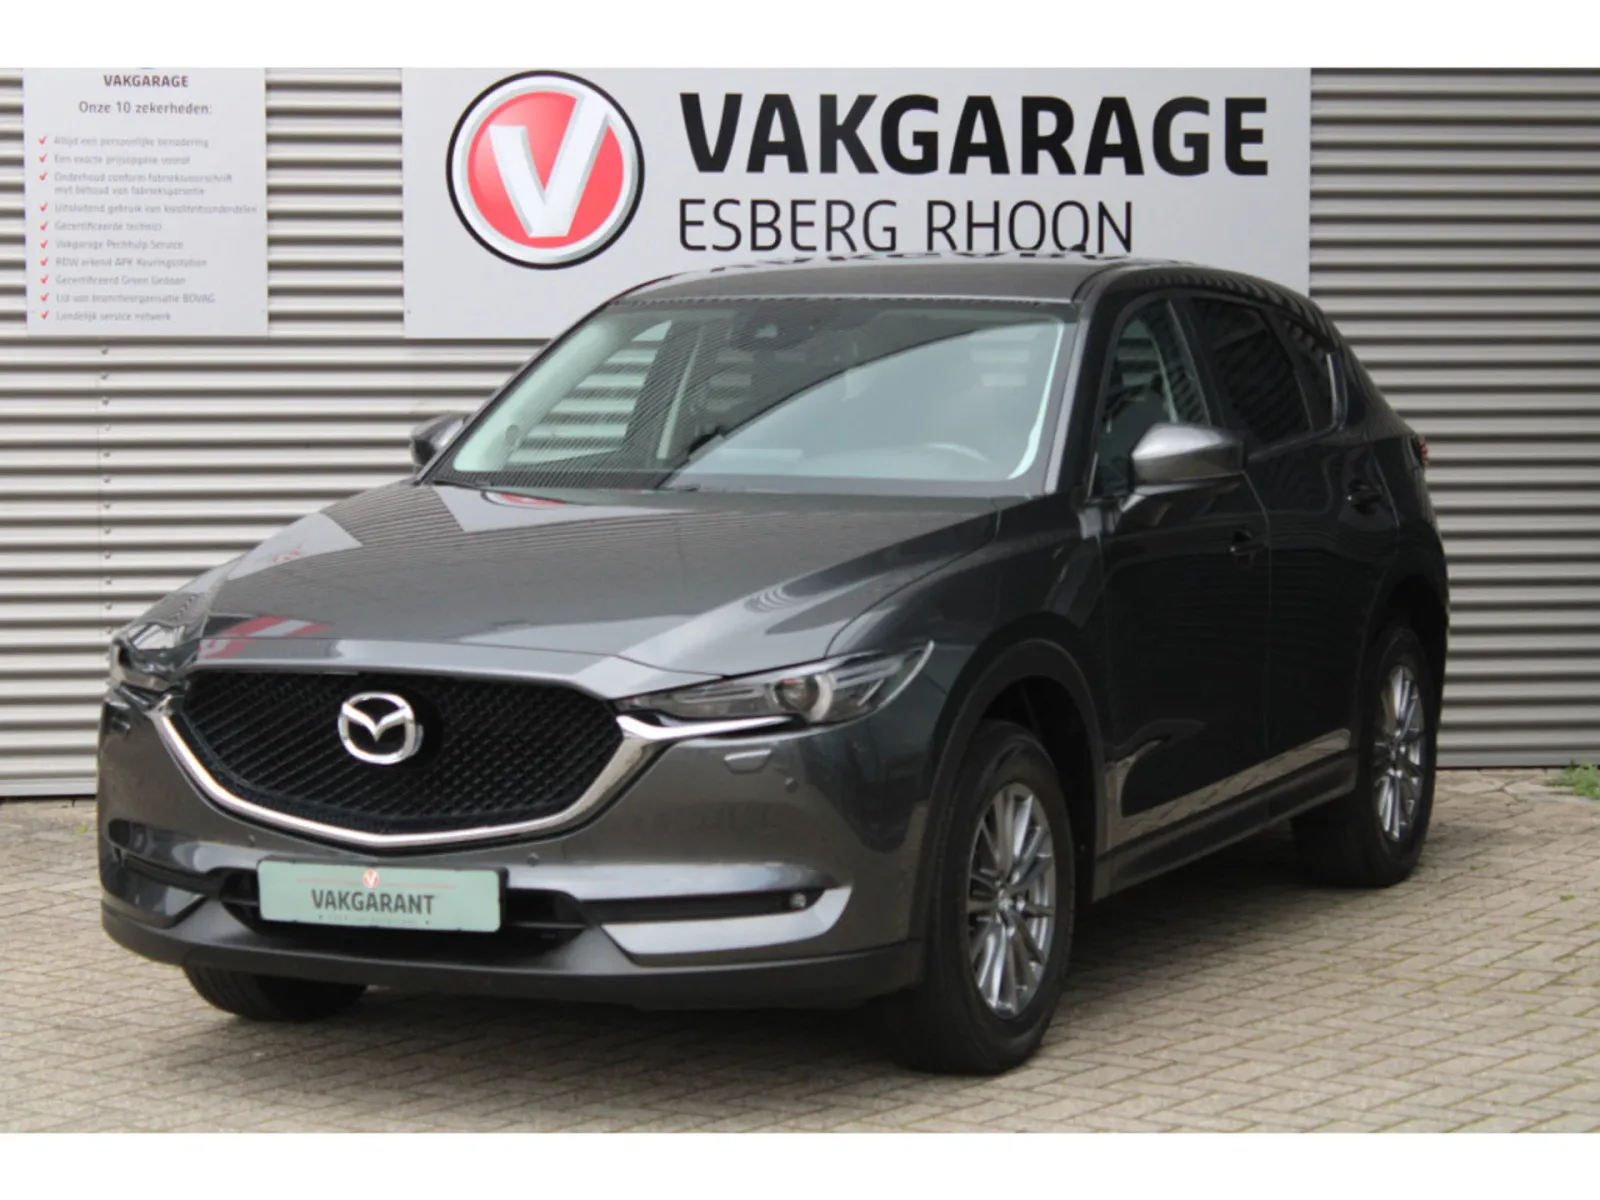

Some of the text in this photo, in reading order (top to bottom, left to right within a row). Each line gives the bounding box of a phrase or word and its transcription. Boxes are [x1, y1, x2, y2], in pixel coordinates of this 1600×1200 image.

[103, 75, 189, 87] VAKGARAGE
[79, 101, 212, 114] Onze 10 zekerheden:
[680, 93, 1268, 176] VAKGARAGE
[54, 155, 71, 163] Een
[54, 173, 106, 182] Onderhoud
[55, 204, 104, 213] Uitsluitend
[108, 204, 141, 215] gebruik
[678, 199, 1133, 255] ESBERG RHOON
[150, 241, 184, 249] Service
[55, 258, 78, 266] RDW
[114, 258, 133, 266] APK
[311, 889, 435, 915] VAKGARANT
